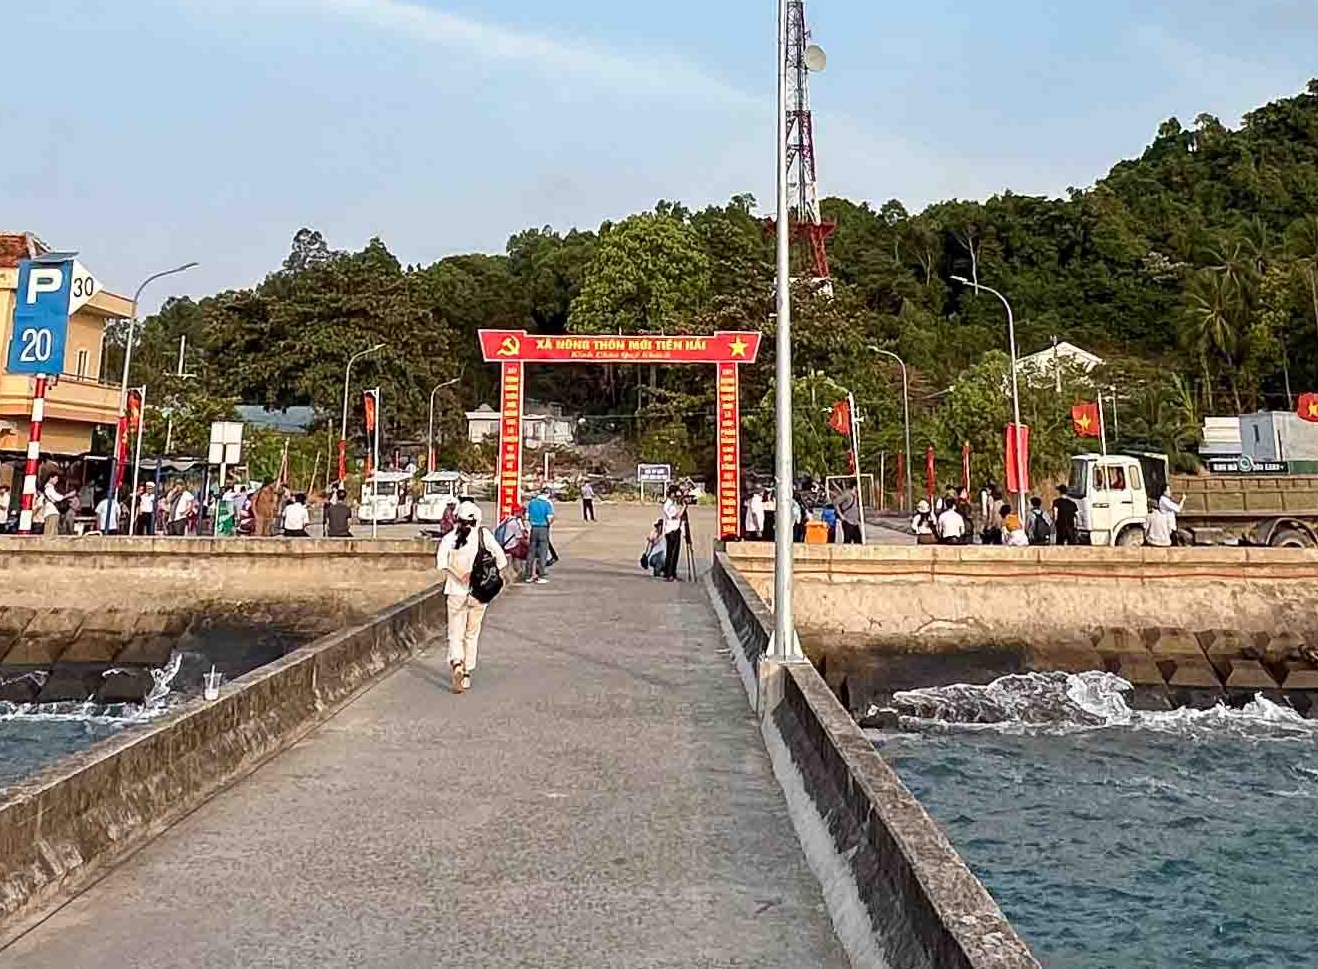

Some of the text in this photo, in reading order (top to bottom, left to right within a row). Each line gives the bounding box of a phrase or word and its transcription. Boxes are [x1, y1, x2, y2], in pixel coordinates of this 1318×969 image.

[26, 268, 63, 304] P
[73, 277, 94, 297] 30
[20, 328, 52, 362] 20
